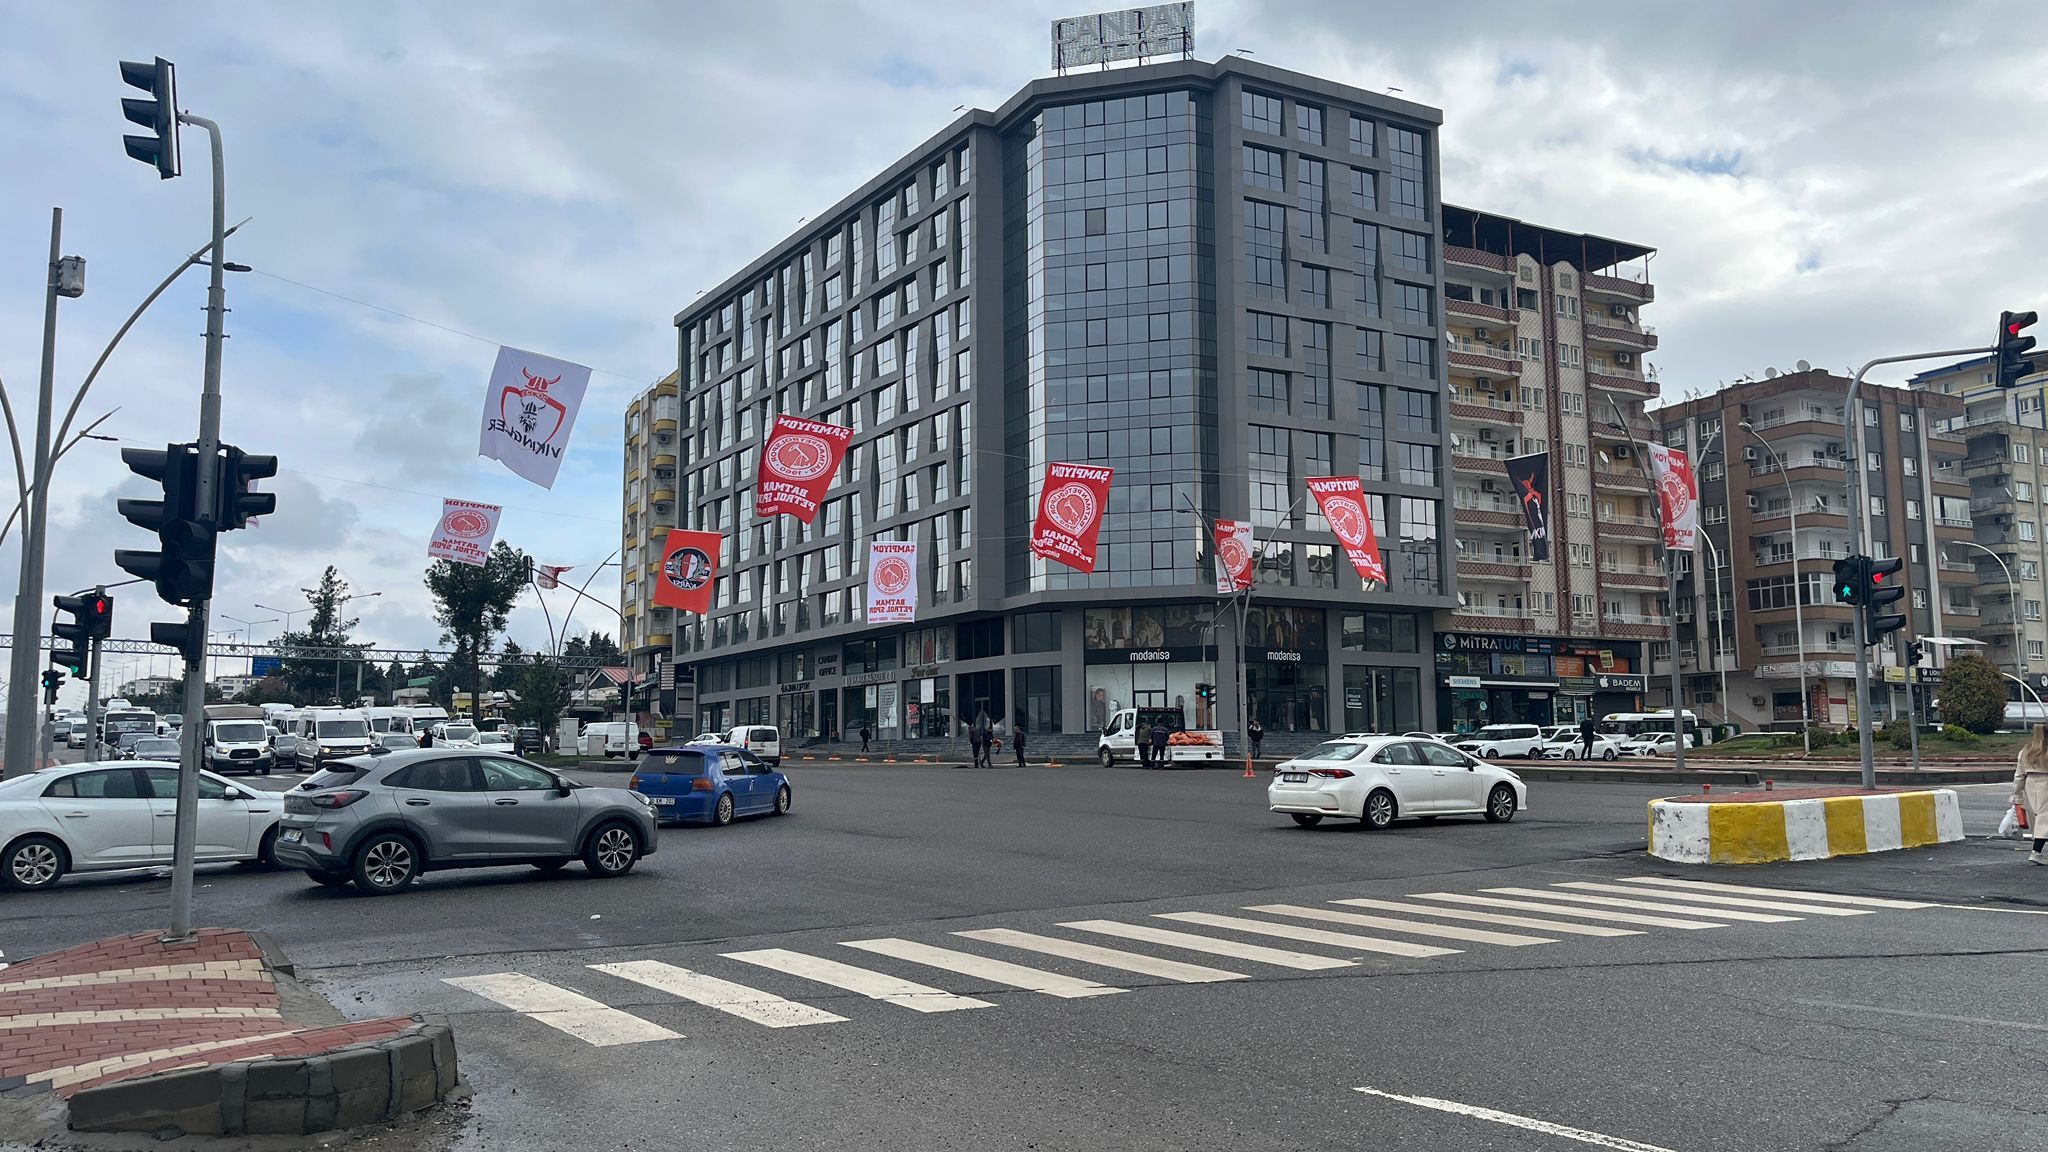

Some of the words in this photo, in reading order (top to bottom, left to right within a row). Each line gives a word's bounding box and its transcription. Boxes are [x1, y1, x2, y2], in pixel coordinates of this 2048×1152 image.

[1129, 649, 1170, 661] modanisa
[1267, 650, 1301, 661] modanisa
[1612, 679, 1641, 687] BADEM
